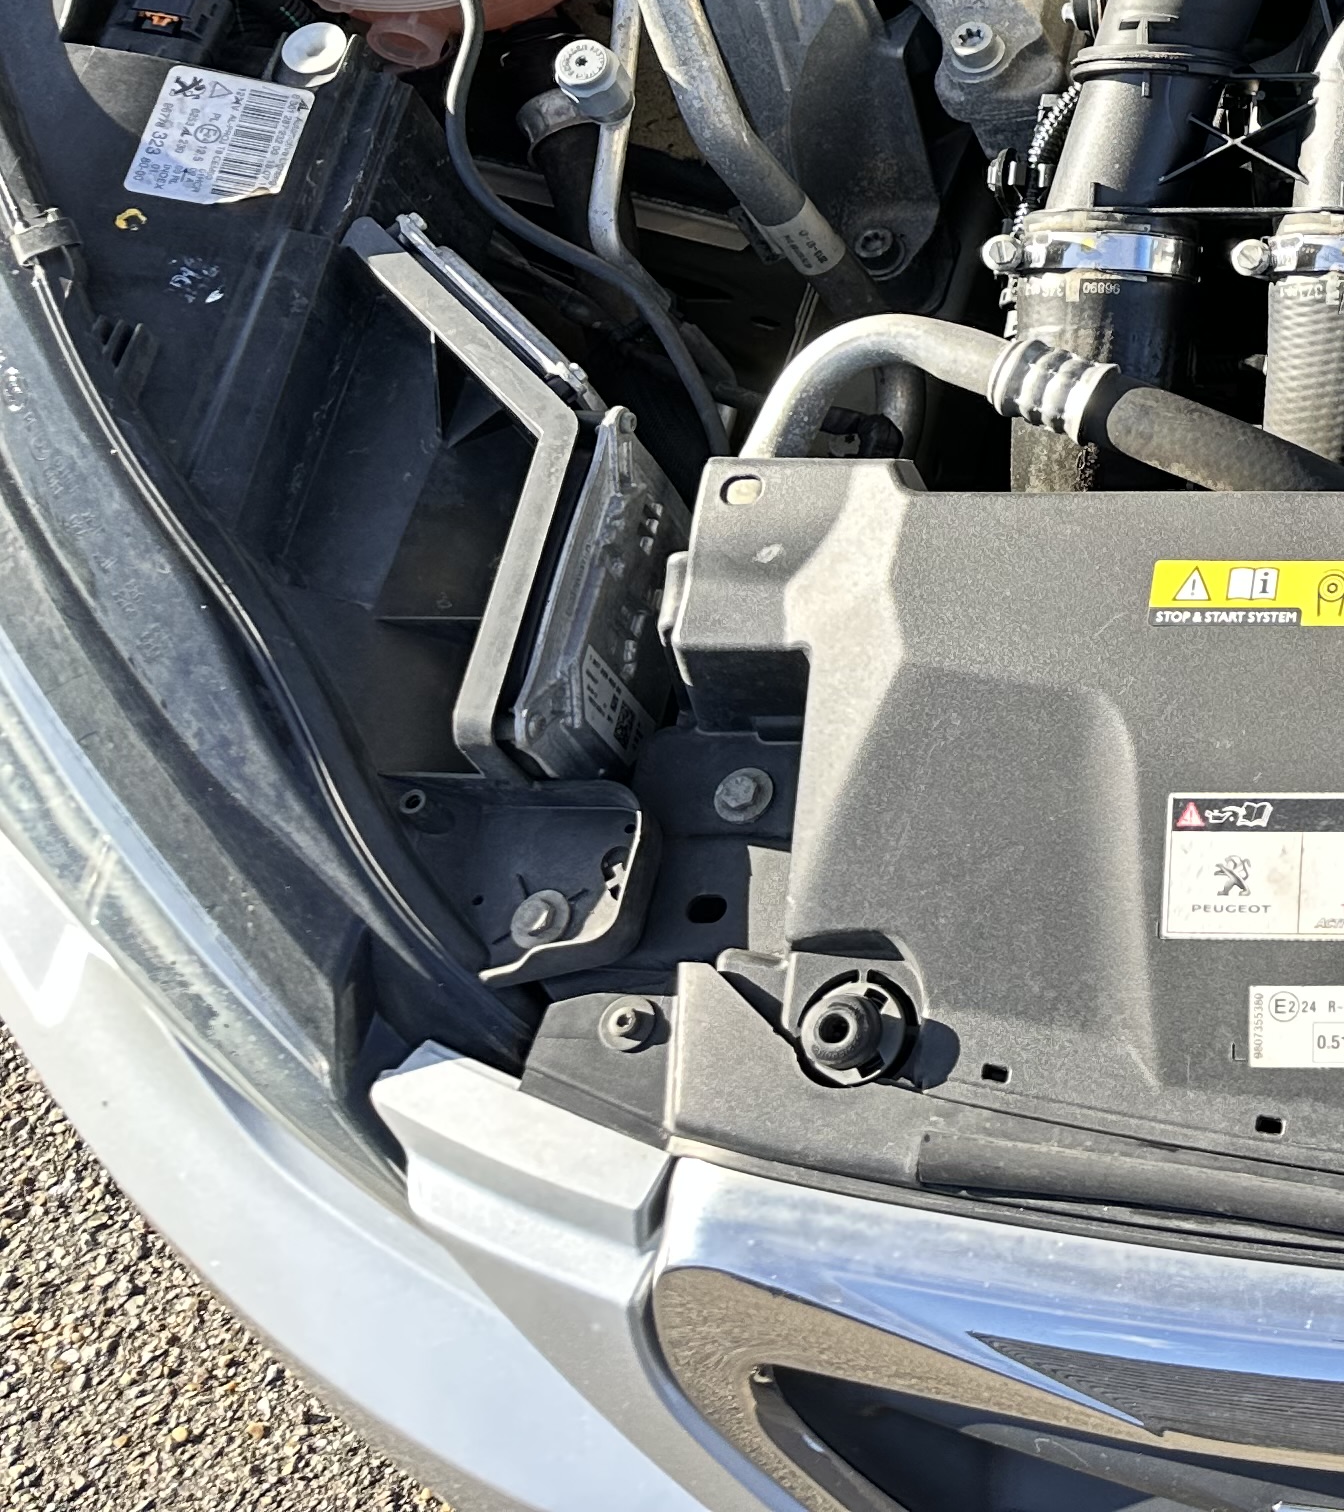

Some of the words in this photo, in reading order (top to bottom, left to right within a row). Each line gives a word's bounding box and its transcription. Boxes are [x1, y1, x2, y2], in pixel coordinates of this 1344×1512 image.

[143, 130, 168, 155] 323
[1155, 611, 1191, 623] STOP
[1192, 611, 1203, 623] &
[1204, 611, 1246, 623] START
[1247, 611, 1297, 623] SYSTEM
[1192, 904, 1271, 914] PEUGEOT
[1301, 1000, 1317, 1013] 24
